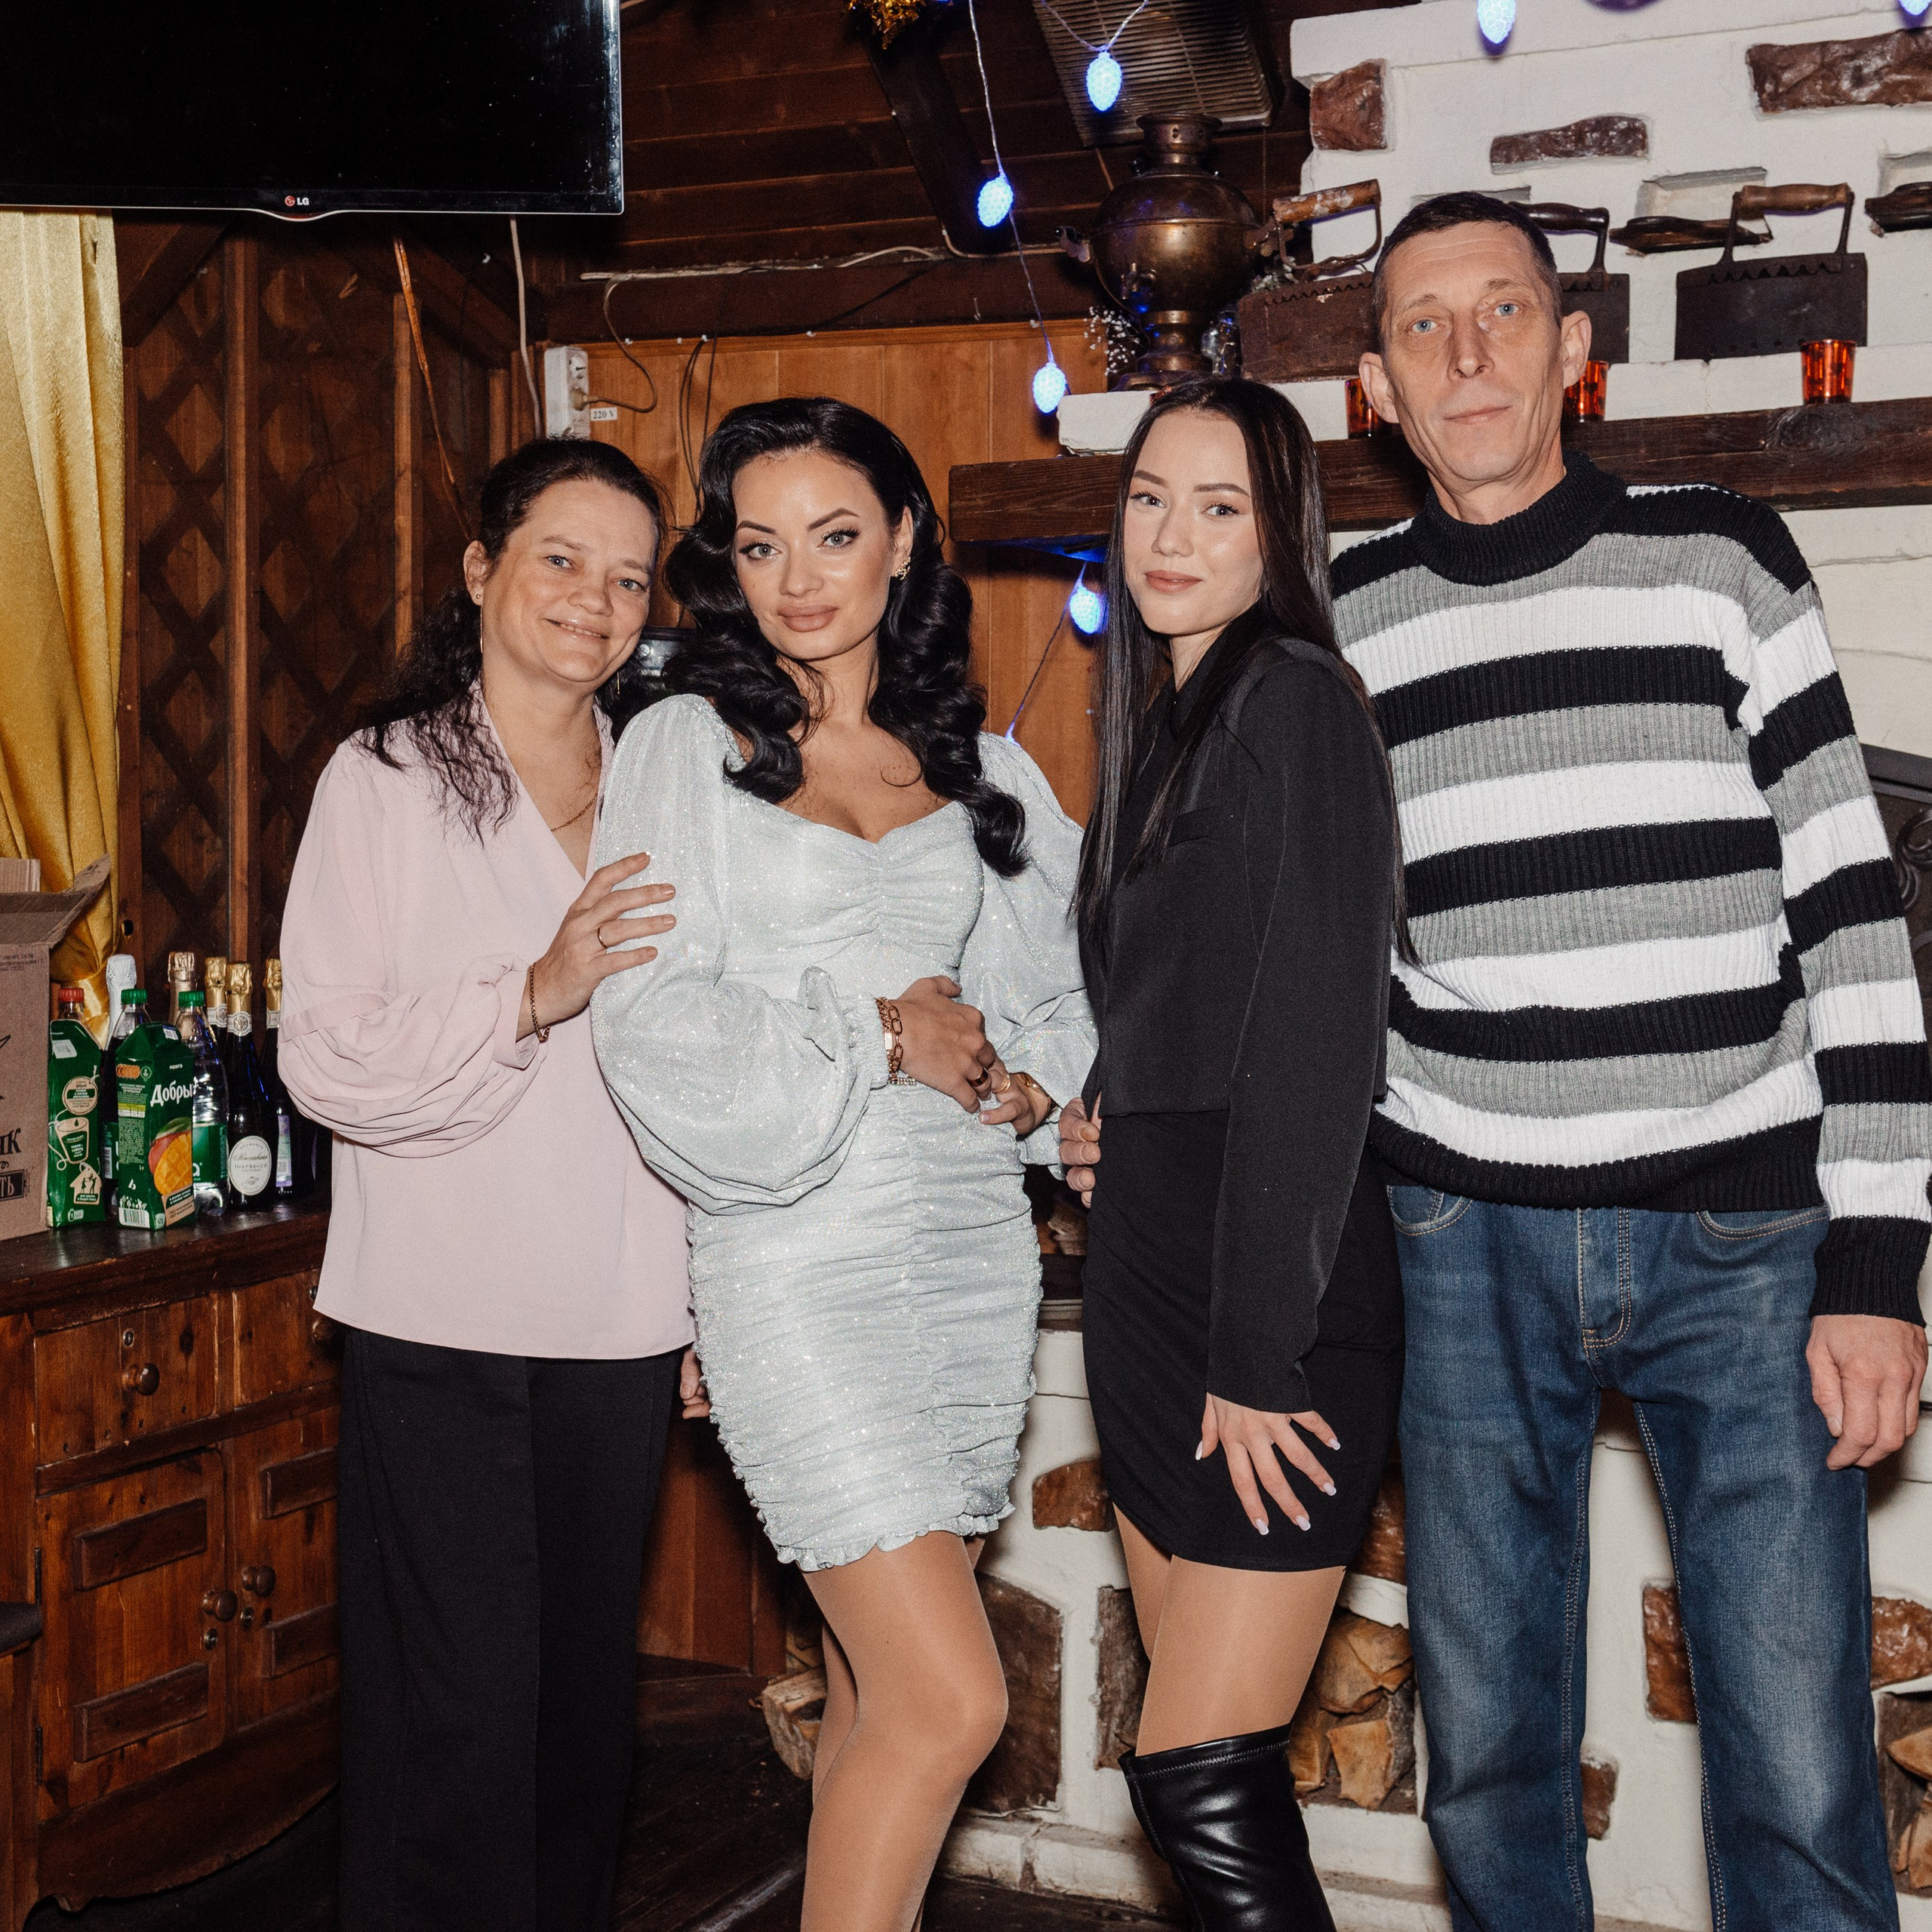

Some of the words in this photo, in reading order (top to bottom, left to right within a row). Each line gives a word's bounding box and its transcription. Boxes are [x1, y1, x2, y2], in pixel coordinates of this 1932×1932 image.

[297, 197, 309, 205] LG
[593, 411, 607, 419] 220
[150, 1080, 193, 1108] Добры
